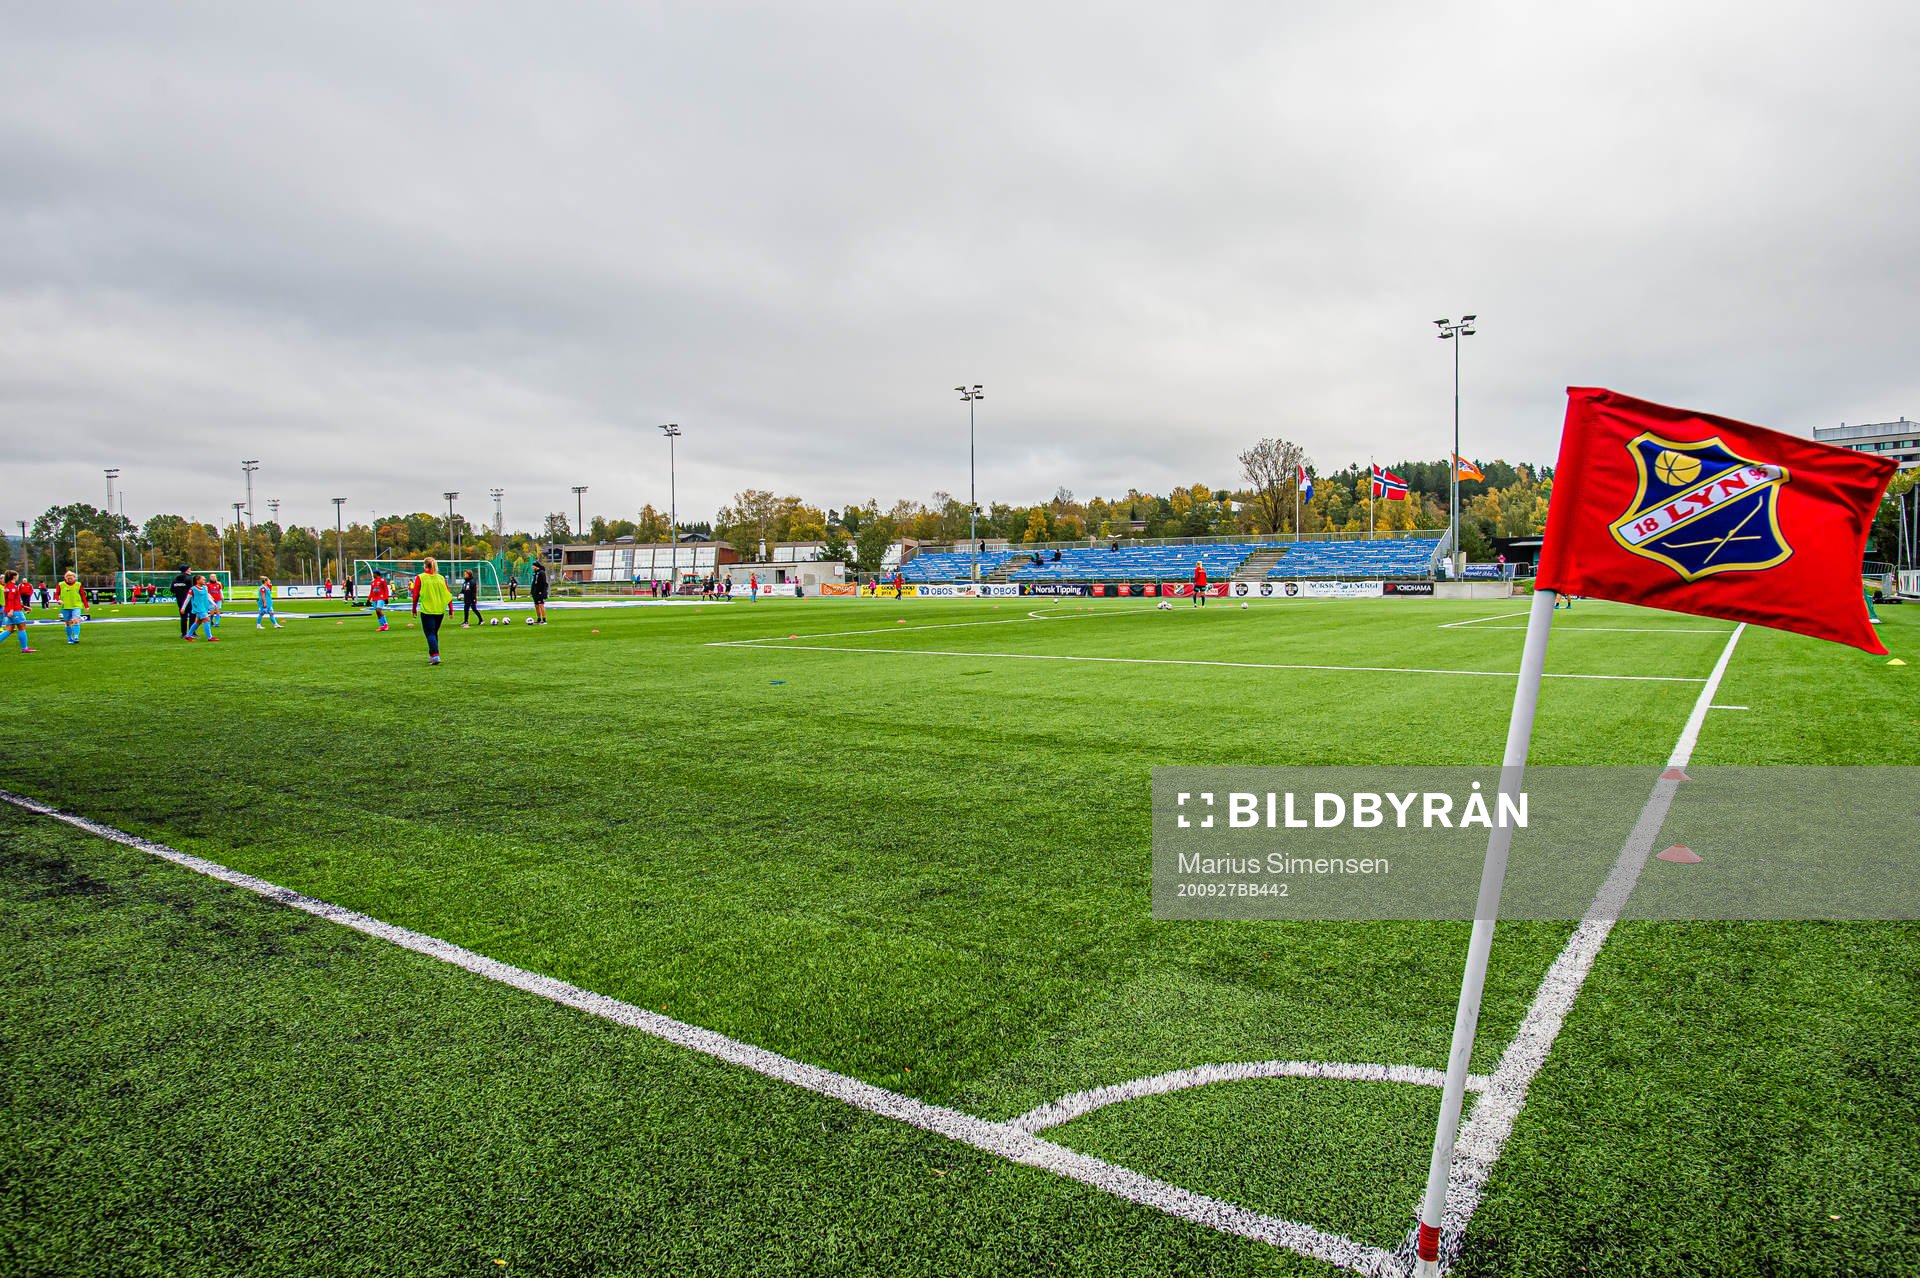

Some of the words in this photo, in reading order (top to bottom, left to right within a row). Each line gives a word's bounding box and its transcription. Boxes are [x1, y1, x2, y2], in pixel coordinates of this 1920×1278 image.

[1633, 517, 1660, 538] 18
[1663, 472, 1750, 525] LYN
[930, 587, 953, 596] OBOS
[992, 587, 1017, 596] OBOS
[1035, 585, 1056, 594] Norsk
[1056, 585, 1083, 596] Tipping
